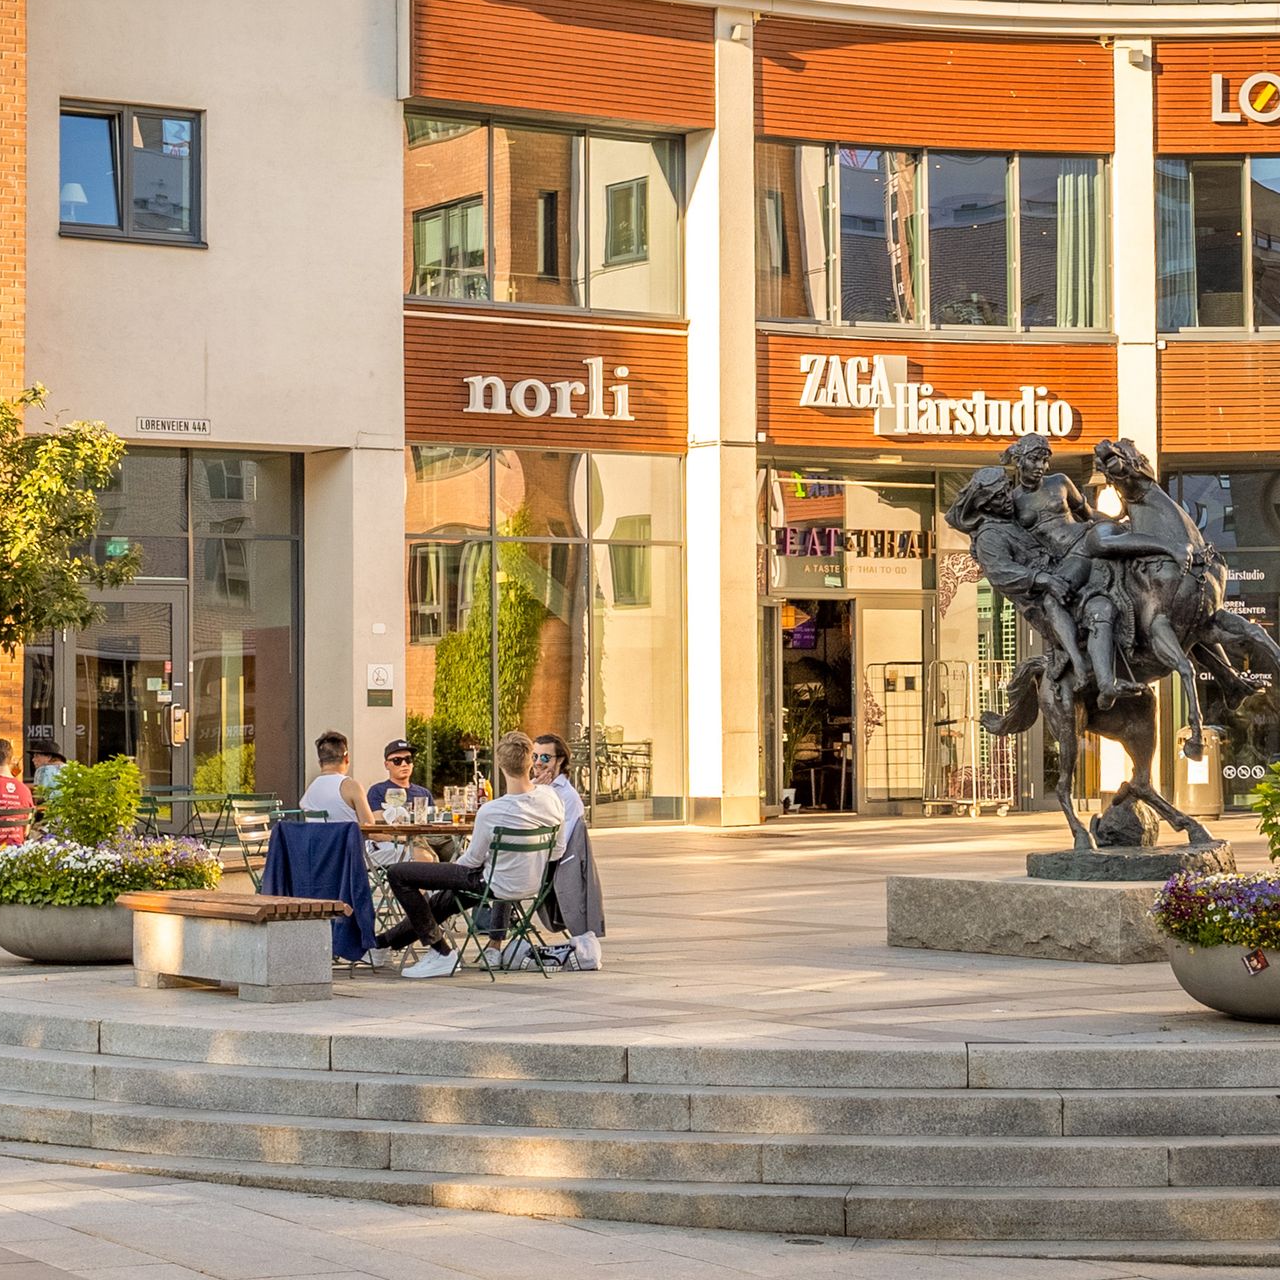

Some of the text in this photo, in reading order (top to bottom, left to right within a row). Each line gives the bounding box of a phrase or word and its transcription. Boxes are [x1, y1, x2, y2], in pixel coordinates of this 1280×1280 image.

[462, 356, 635, 421] norli
[799, 354, 1074, 438] ZAGA Hårstudio
[140, 419, 208, 433] LØRENVEIEN 44A
[785, 527, 841, 558] EAT
[804, 564, 810, 573] A
[813, 564, 841, 574] TASTE
[858, 565, 878, 574] THAI
[881, 566, 892, 574] TO
